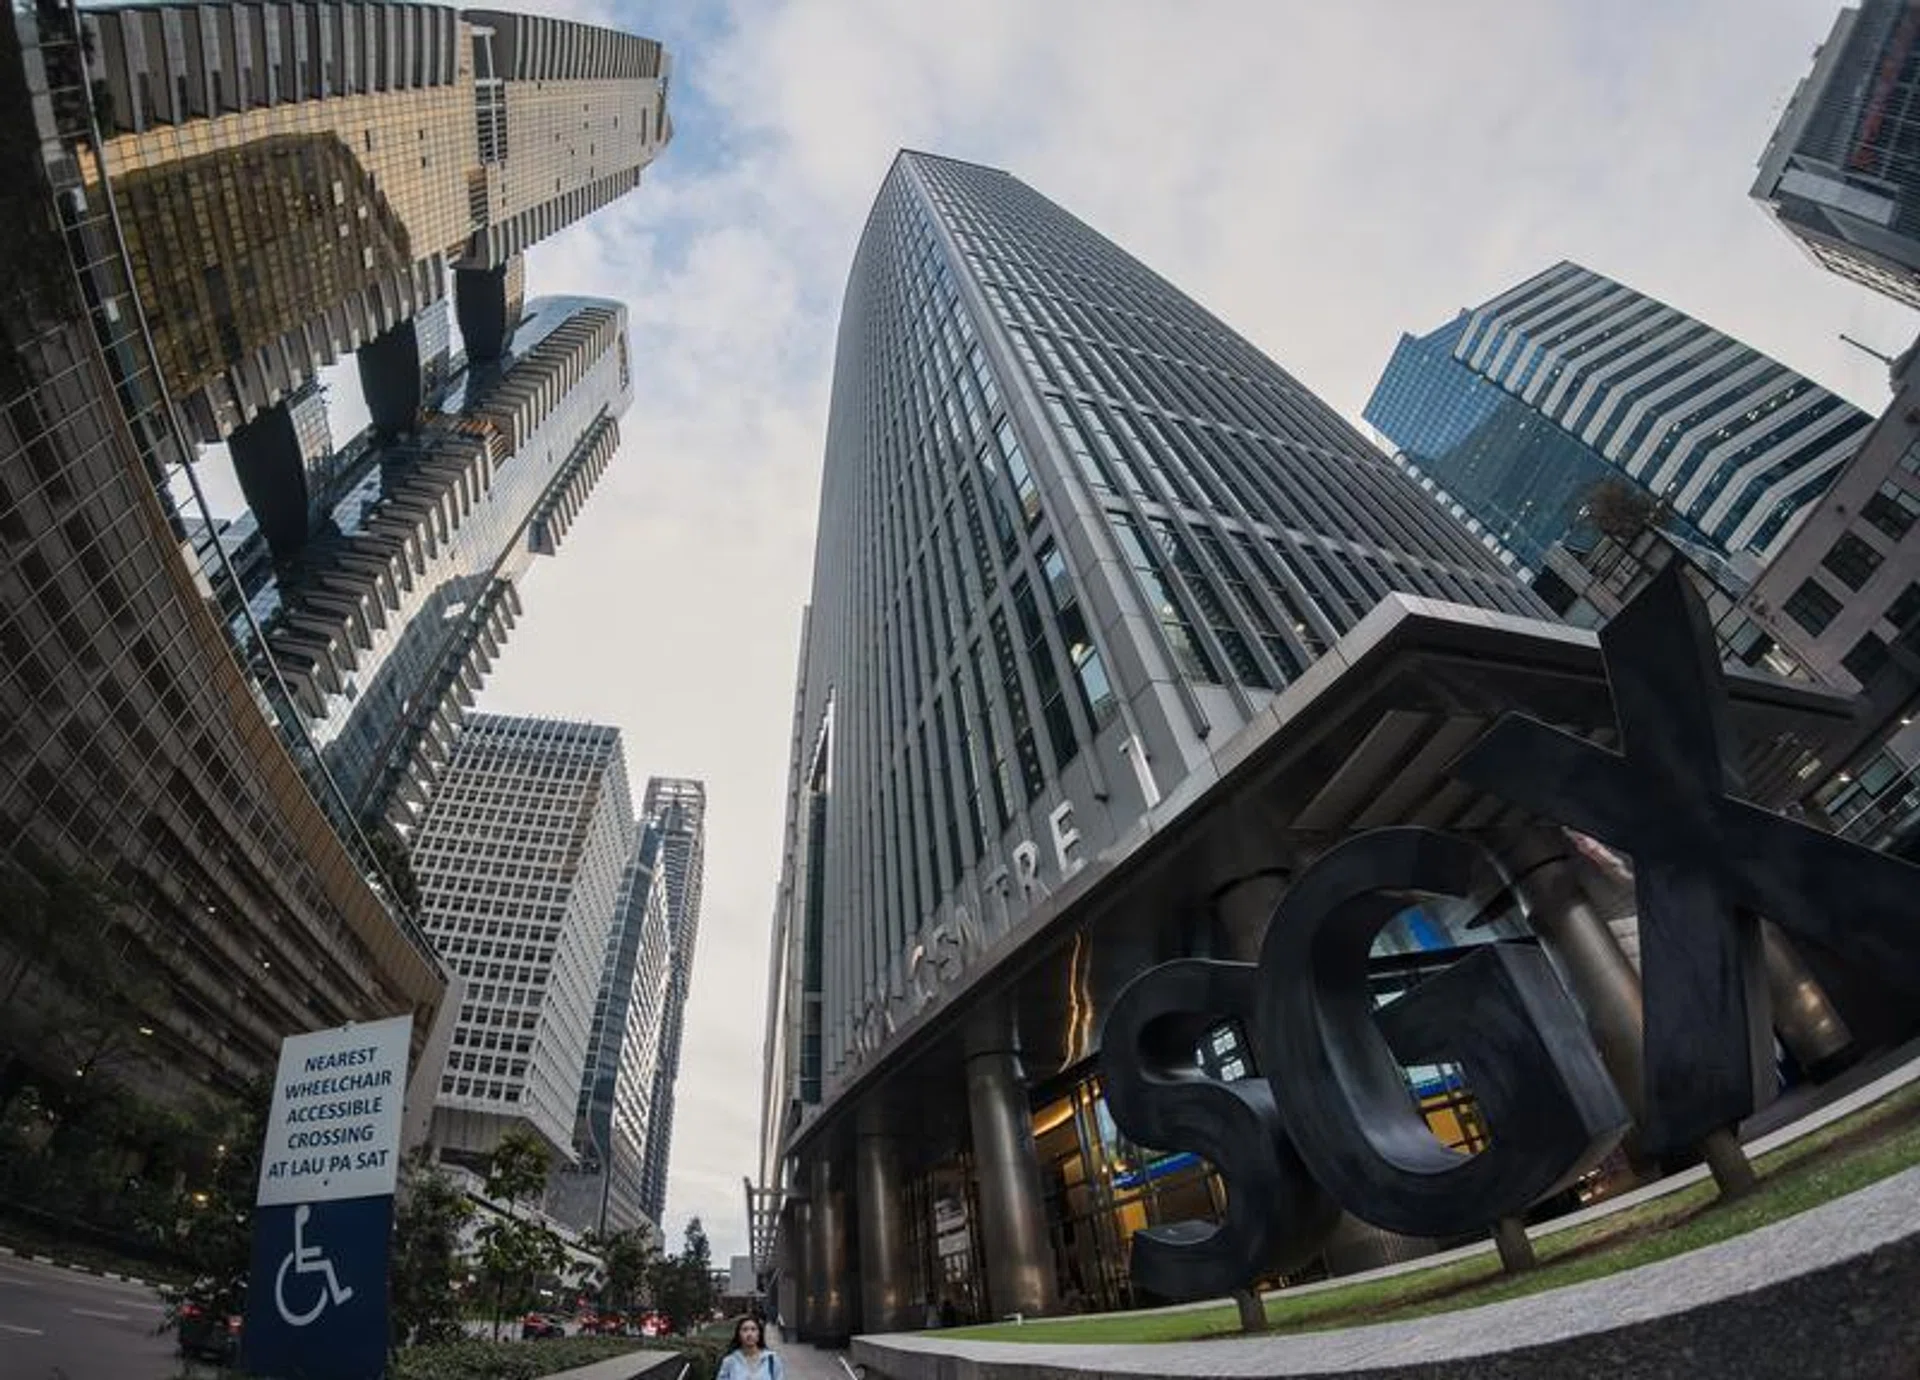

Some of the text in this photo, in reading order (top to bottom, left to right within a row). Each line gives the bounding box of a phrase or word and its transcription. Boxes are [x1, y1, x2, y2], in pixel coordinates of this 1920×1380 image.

[908, 800, 1089, 1018] CENTRE
[1101, 563, 1920, 1302] SGX
[305, 1046, 379, 1072] NEAREST
[285, 1070, 392, 1101] WHEELCHAIR
[286, 1097, 383, 1125] ACCESSIBLE
[288, 1124, 375, 1150] CROSSING
[267, 1149, 390, 1180] AT LAU PA SAT
